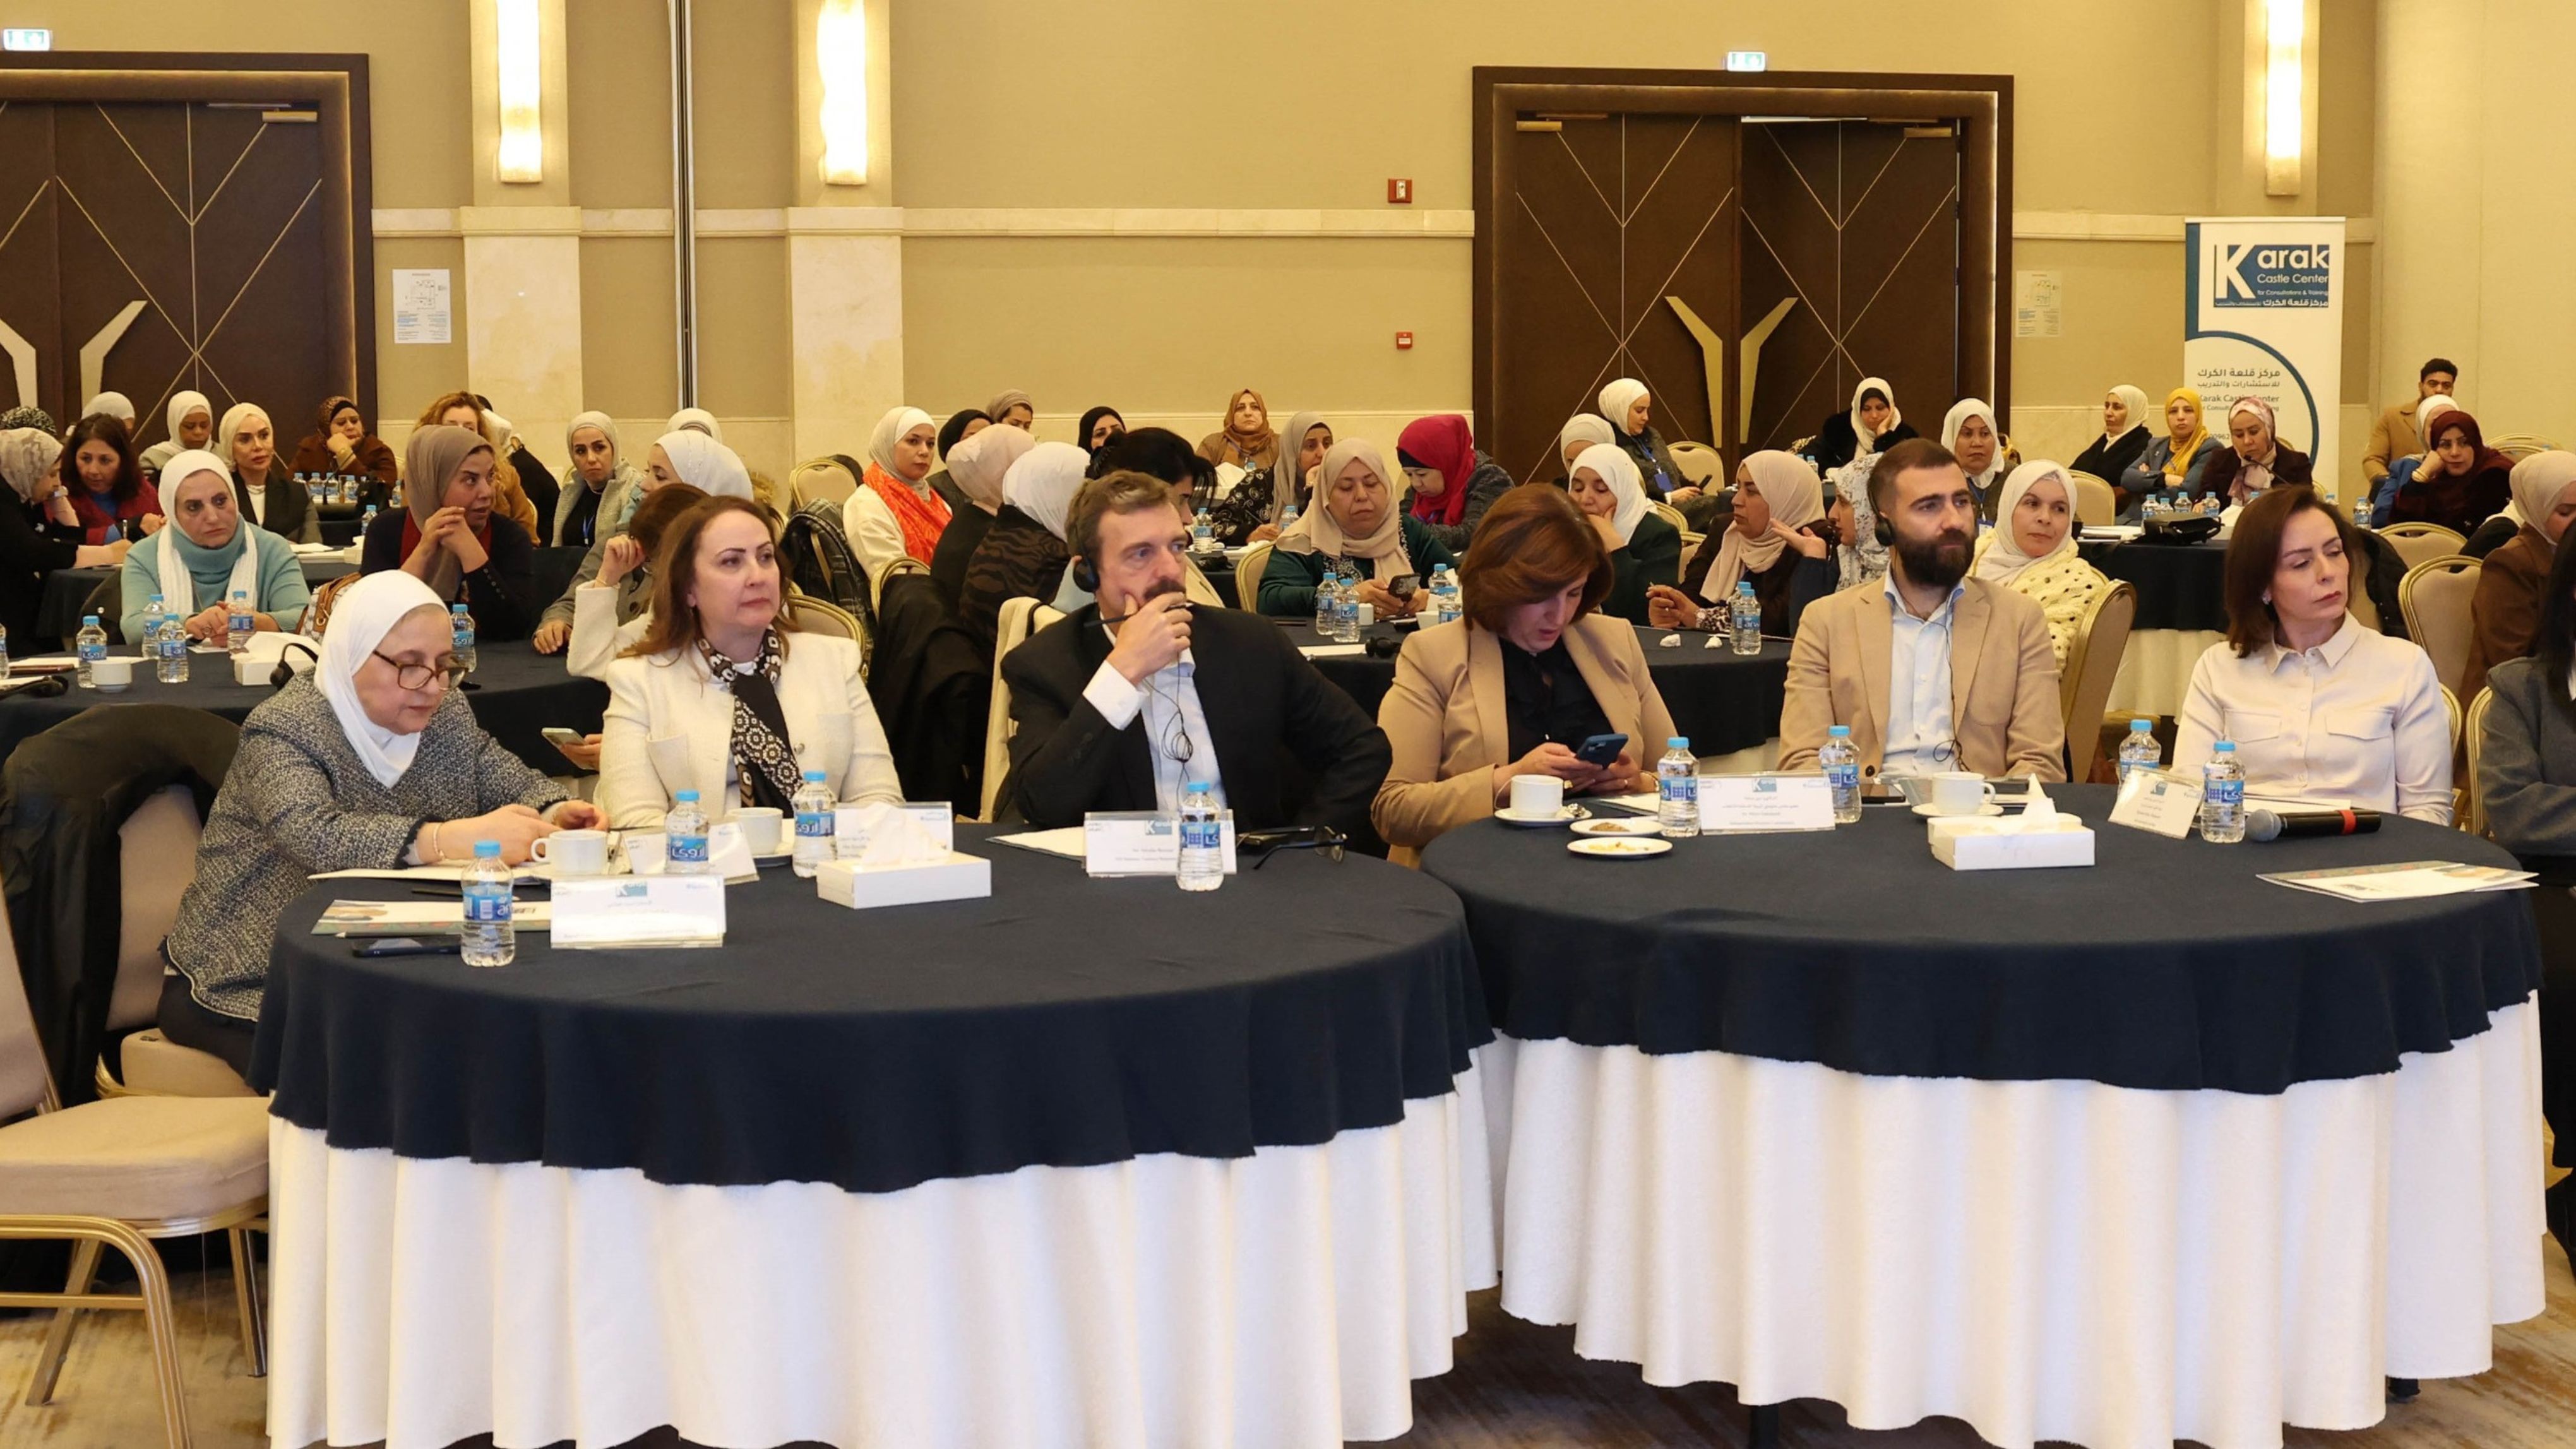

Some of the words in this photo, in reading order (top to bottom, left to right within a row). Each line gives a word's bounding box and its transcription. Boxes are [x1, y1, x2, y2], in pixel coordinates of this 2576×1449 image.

[2215, 244, 2329, 299] Karak
[2257, 273, 2290, 283] Castle
[2292, 273, 2329, 283] Center
[2263, 298, 2287, 307] الكرك
[2287, 298, 2309, 306] قلعة
[2197, 368, 2226, 378] الكرك
[2229, 369, 2255, 377] قلعة
[2257, 369, 2281, 379] مركز
[2197, 380, 2230, 388] والتدريب
[2232, 380, 2280, 388] للاستشارات
